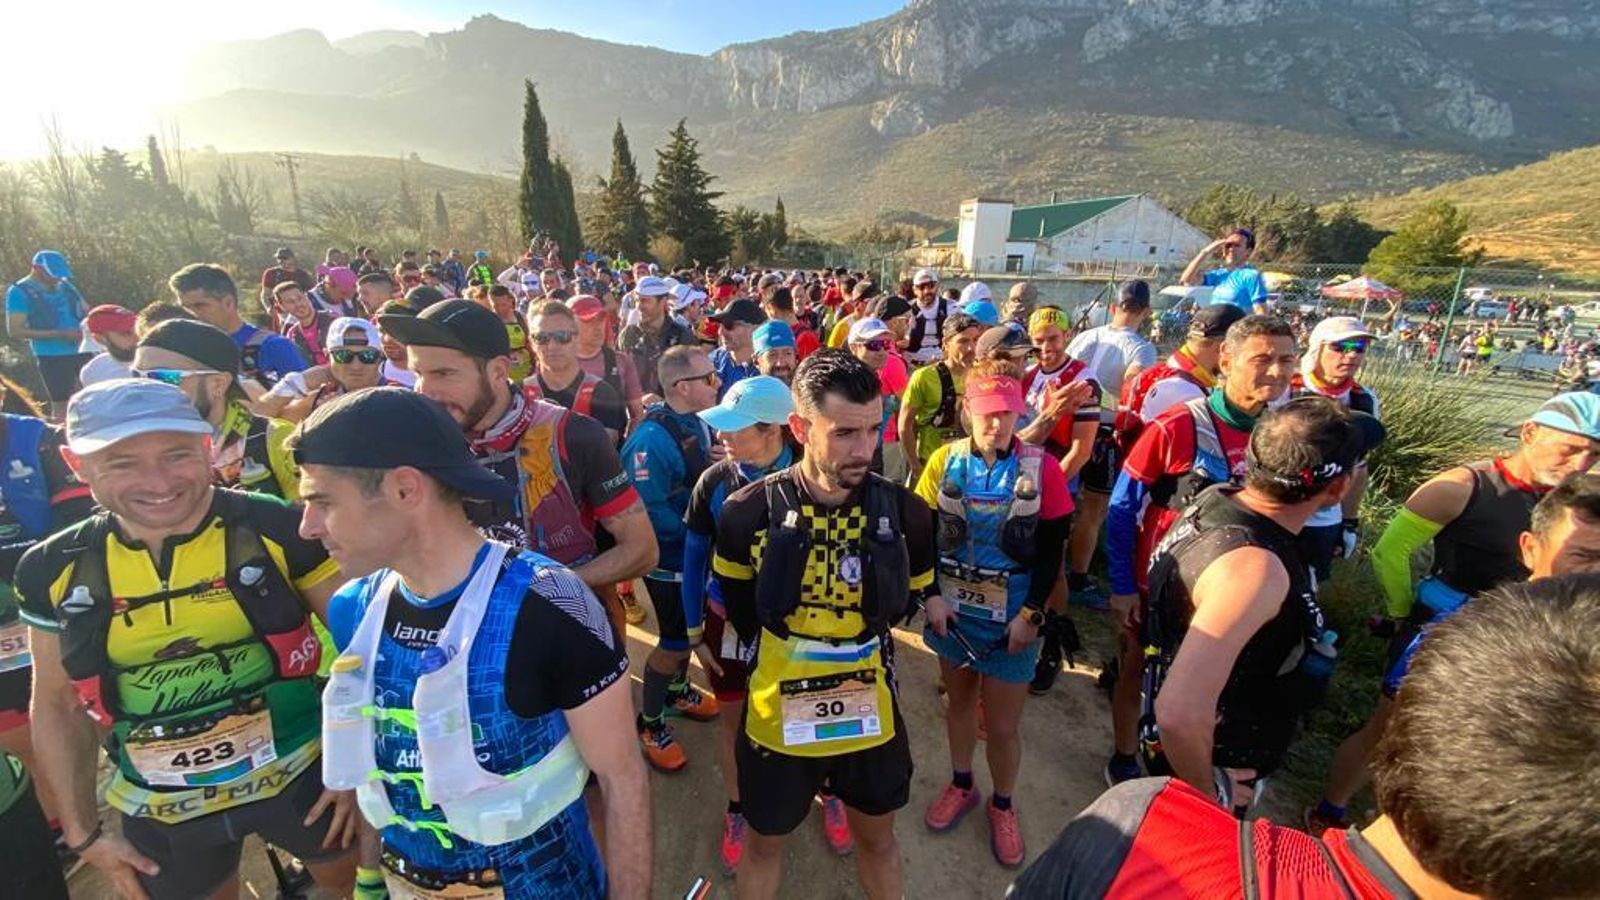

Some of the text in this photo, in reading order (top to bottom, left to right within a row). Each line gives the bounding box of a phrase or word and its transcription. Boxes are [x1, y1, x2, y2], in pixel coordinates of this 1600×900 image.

[957, 588, 986, 604] 373
[815, 701, 845, 718] 30
[170, 741, 236, 768] 423
[228, 761, 296, 799] MAX
